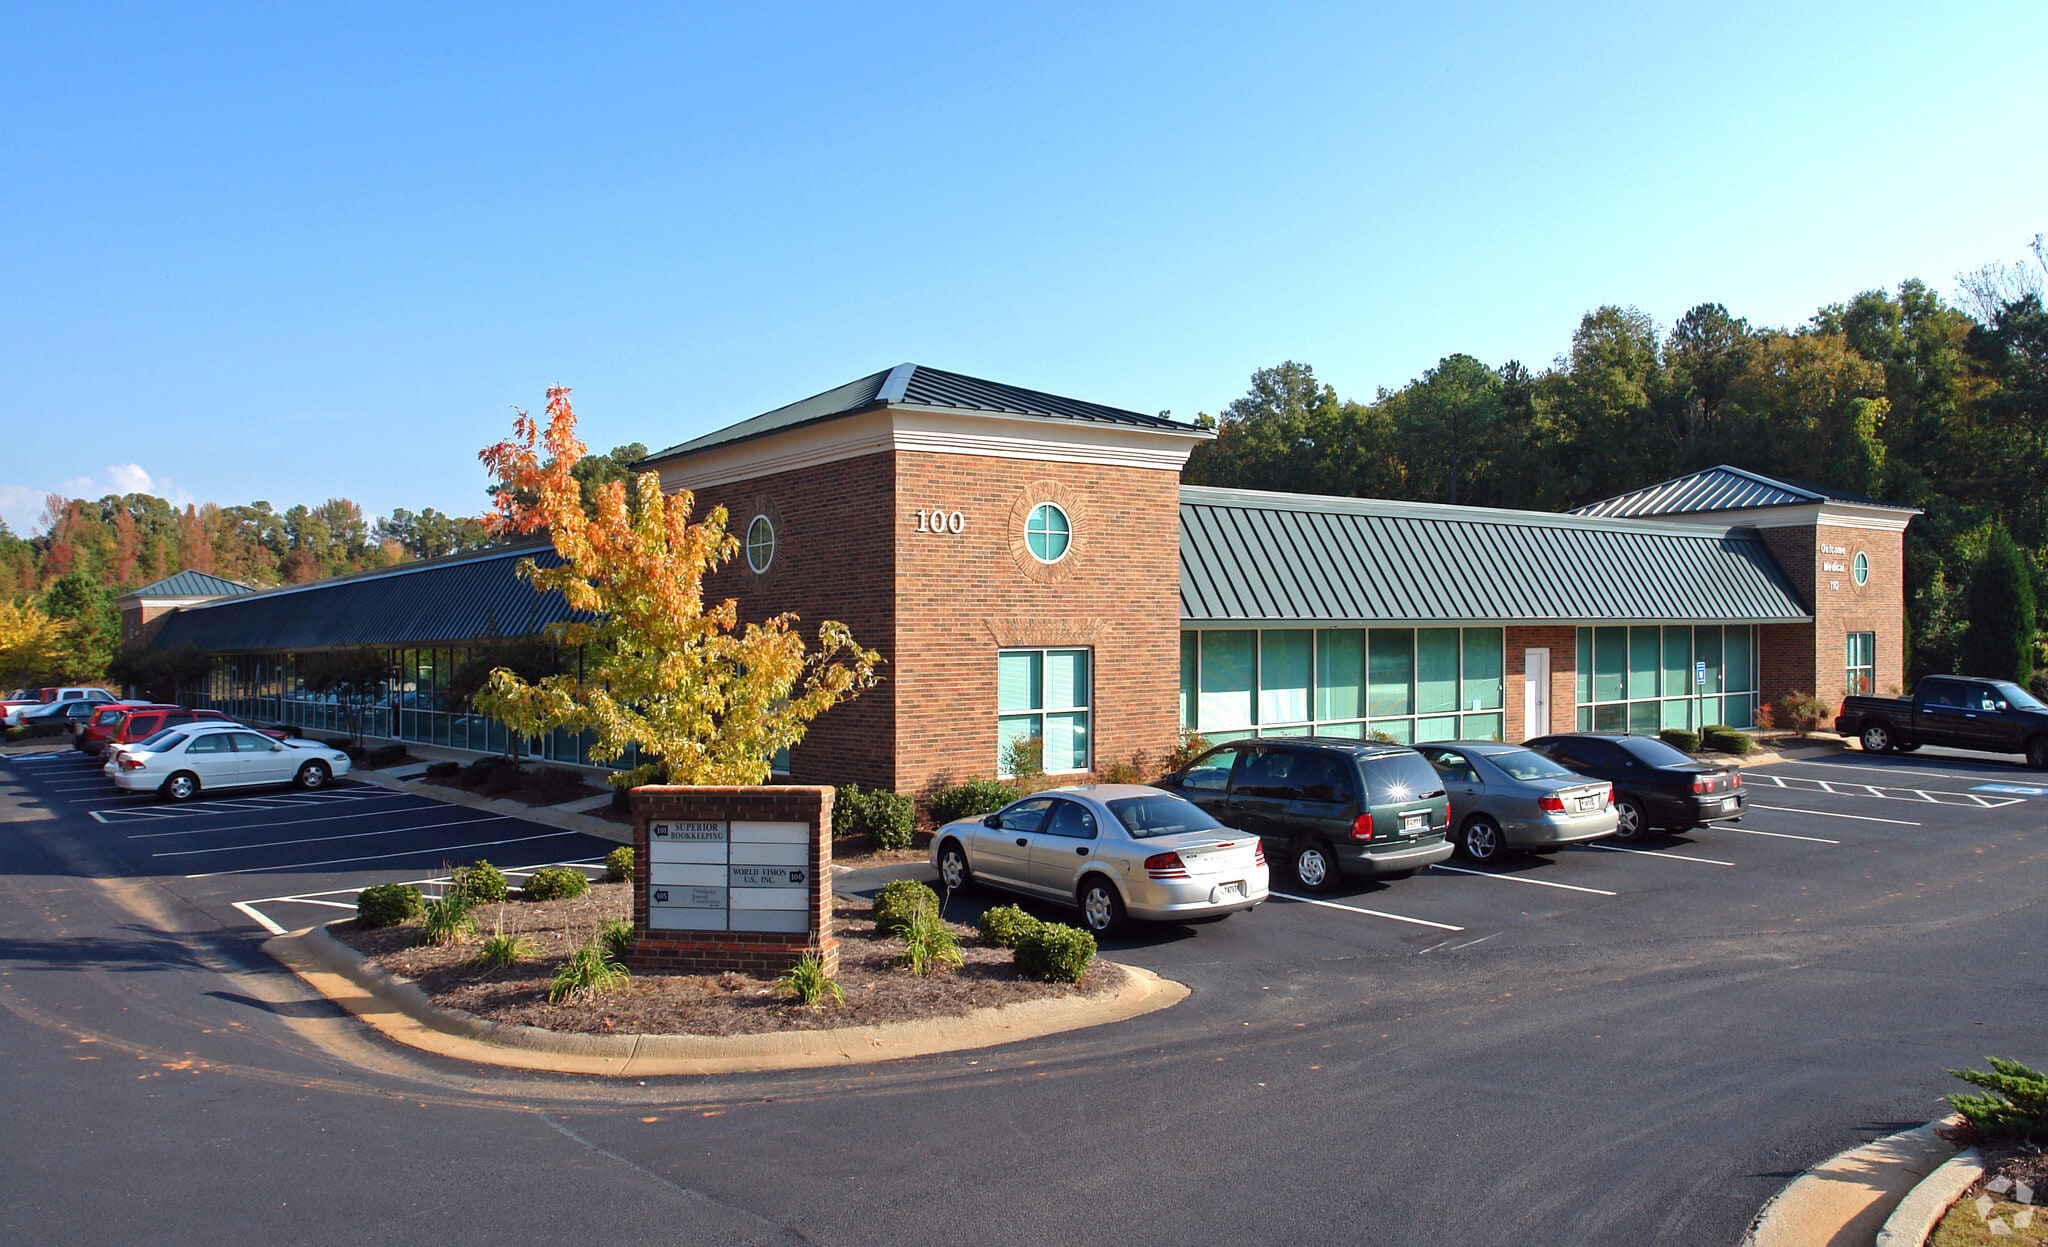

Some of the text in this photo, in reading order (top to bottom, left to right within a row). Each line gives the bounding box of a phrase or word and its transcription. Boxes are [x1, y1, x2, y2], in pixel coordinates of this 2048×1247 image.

[916, 509, 965, 534] 100
[1823, 560, 1845, 572] Medical
[656, 826, 668, 834] 101
[675, 823, 718, 831] SUPERIOR
[671, 832, 724, 840] BOOKKEEPING
[733, 868, 787, 876] WORLD VISION
[761, 876, 776, 884] INC.
[790, 873, 803, 881] 106
[656, 892, 668, 900] 105
